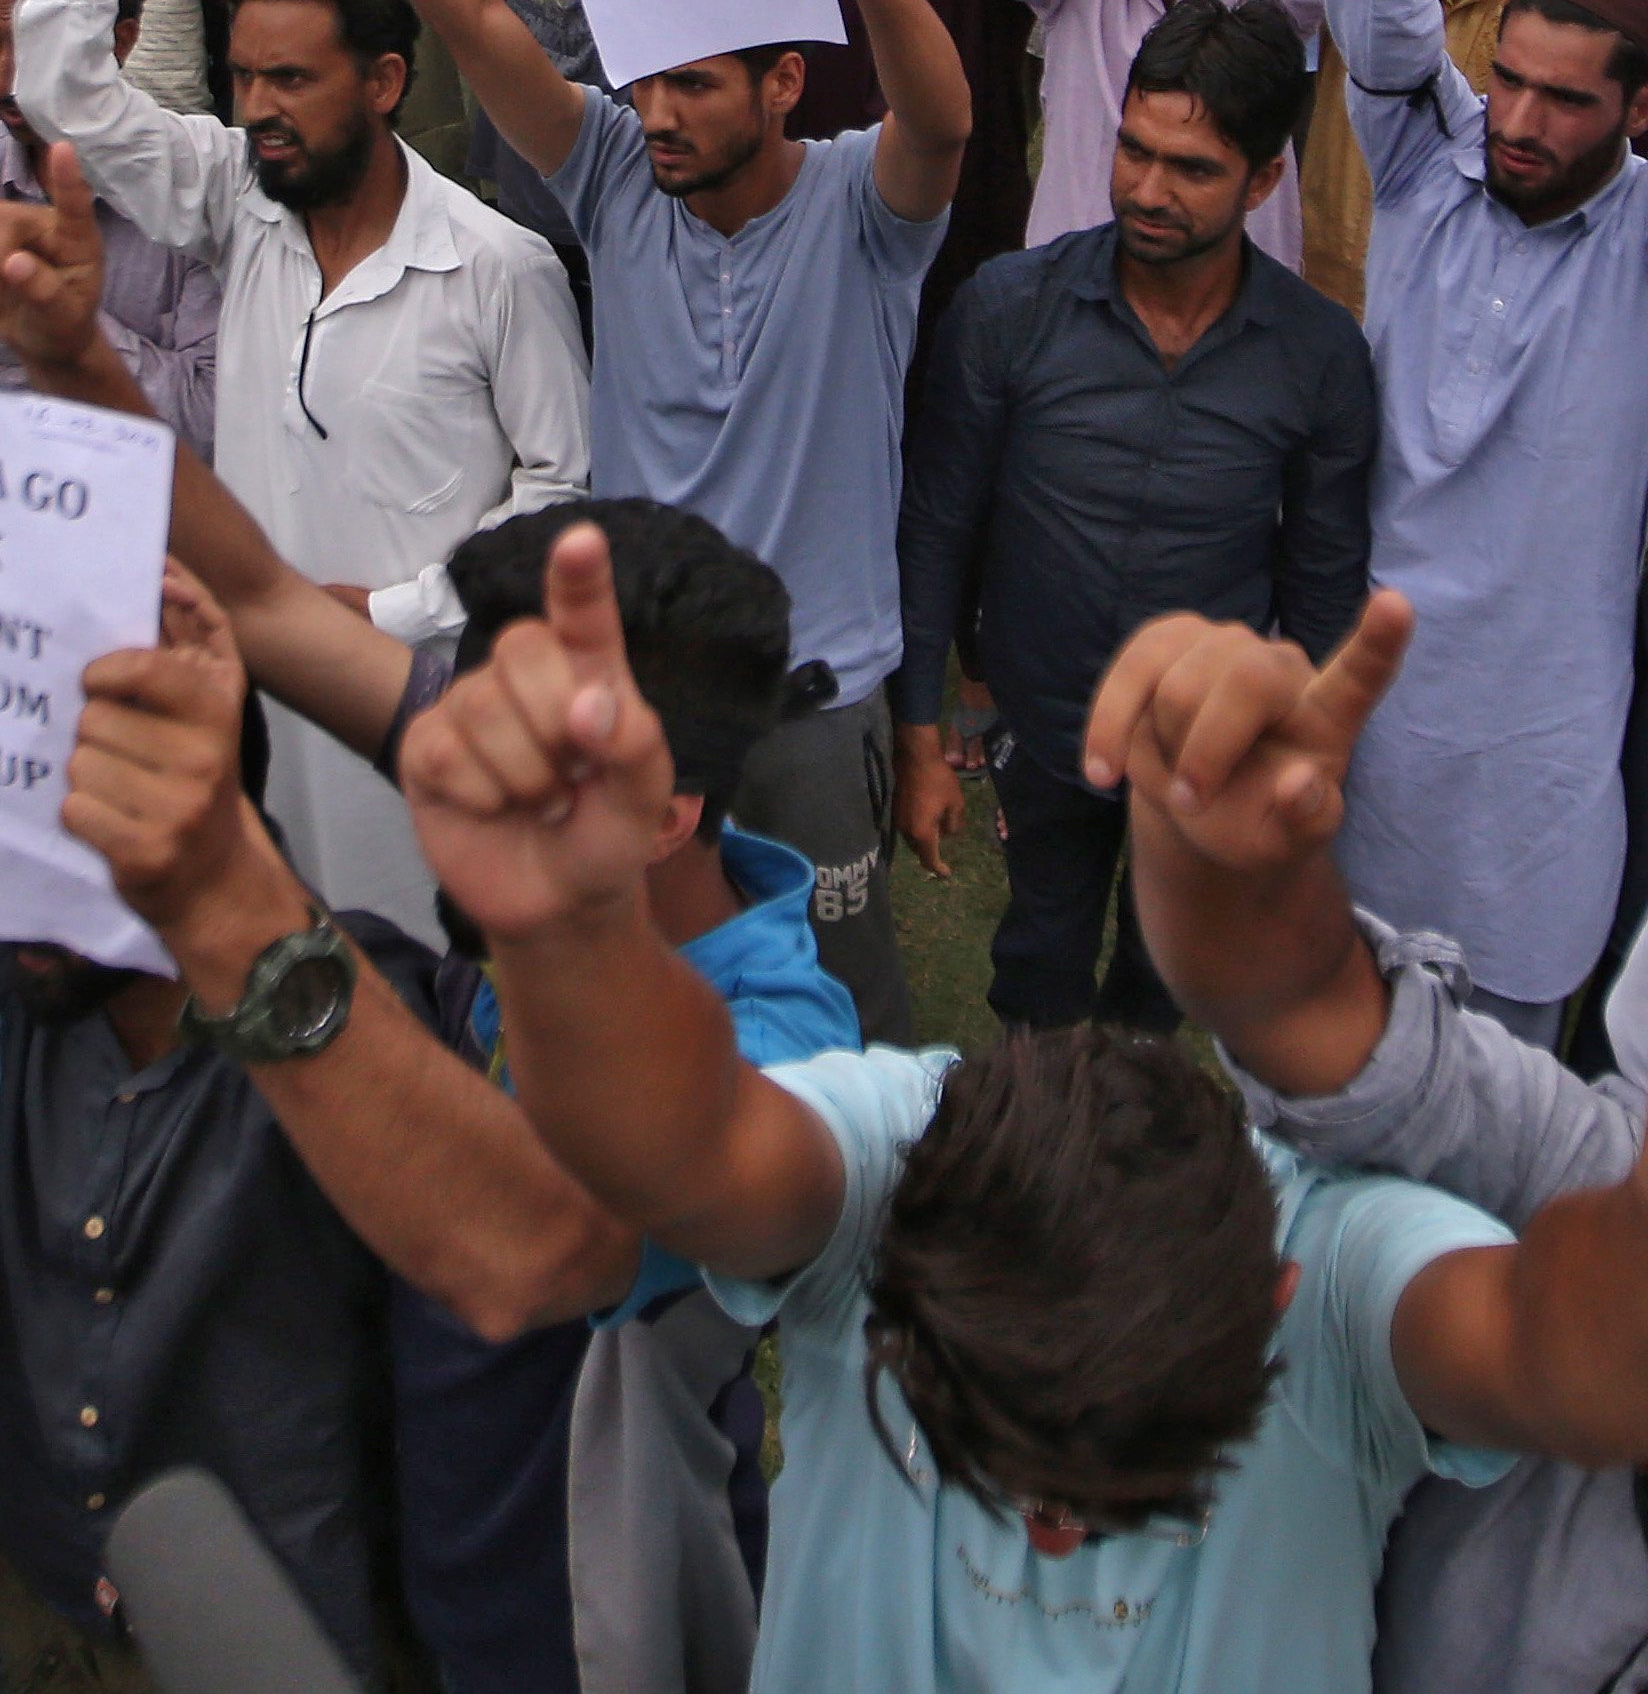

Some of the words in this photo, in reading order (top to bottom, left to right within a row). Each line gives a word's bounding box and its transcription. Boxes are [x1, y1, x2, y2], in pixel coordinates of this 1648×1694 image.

[21, 471, 90, 521] GO
[816, 846, 879, 888] OMMY
[816, 886, 868, 922] 85
